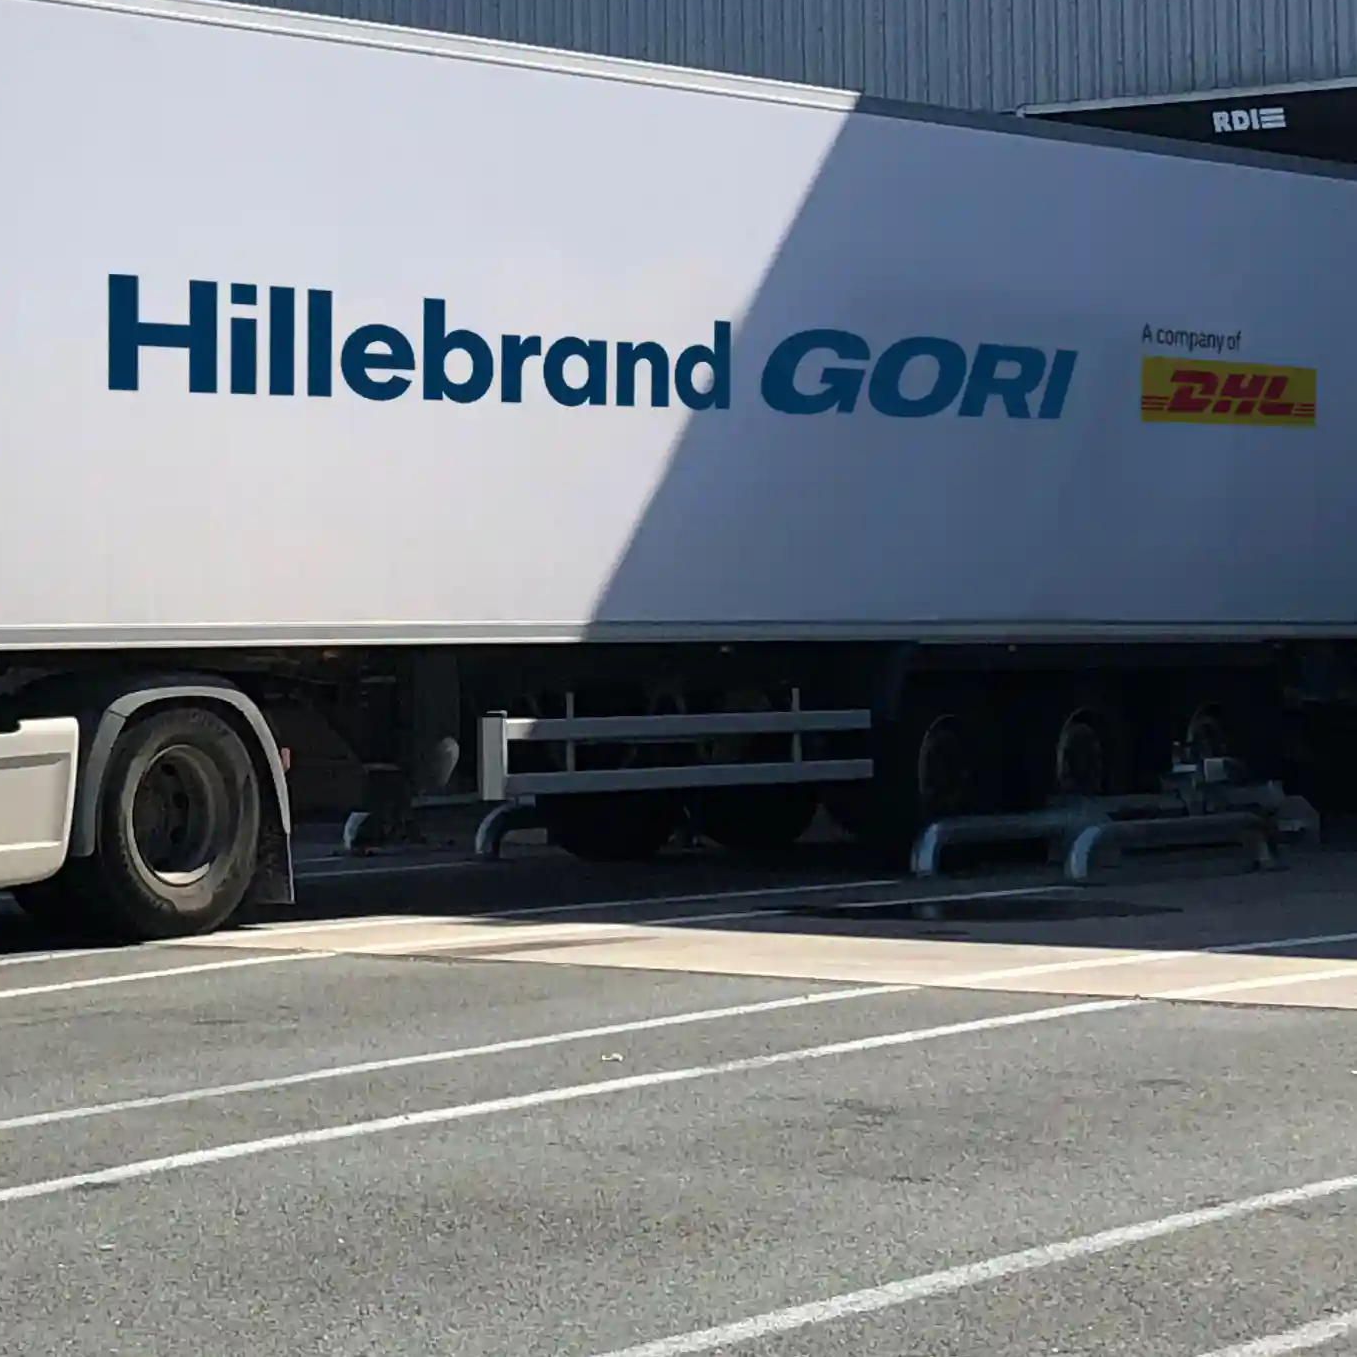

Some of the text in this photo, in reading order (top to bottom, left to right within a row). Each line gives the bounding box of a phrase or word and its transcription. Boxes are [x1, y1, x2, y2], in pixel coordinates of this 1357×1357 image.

[108, 273, 1079, 419] Hillebrand GORI
[1142, 322, 1242, 354] A company of
[1166, 369, 1295, 416] DHL
